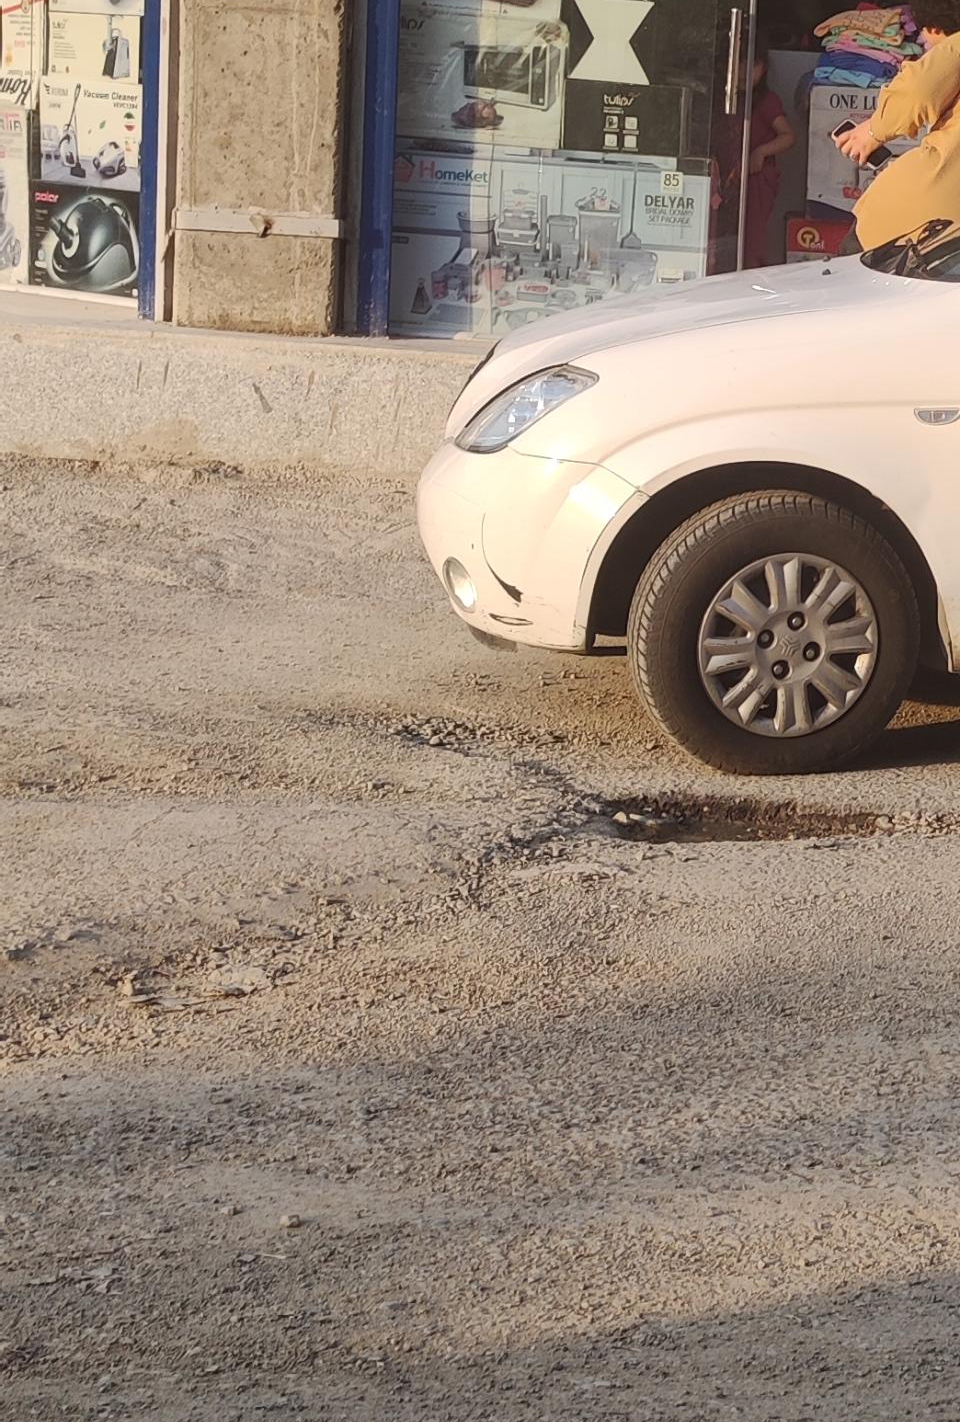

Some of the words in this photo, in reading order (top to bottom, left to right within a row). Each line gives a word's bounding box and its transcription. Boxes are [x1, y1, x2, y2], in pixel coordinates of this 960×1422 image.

[83, 89, 110, 100] Vacuum
[111, 91, 138, 102] Cleaner
[829, 93, 858, 110] ONE
[420, 160, 489, 184] HomeKet
[663, 173, 680, 187] 85
[644, 194, 695, 210] DELYAR
